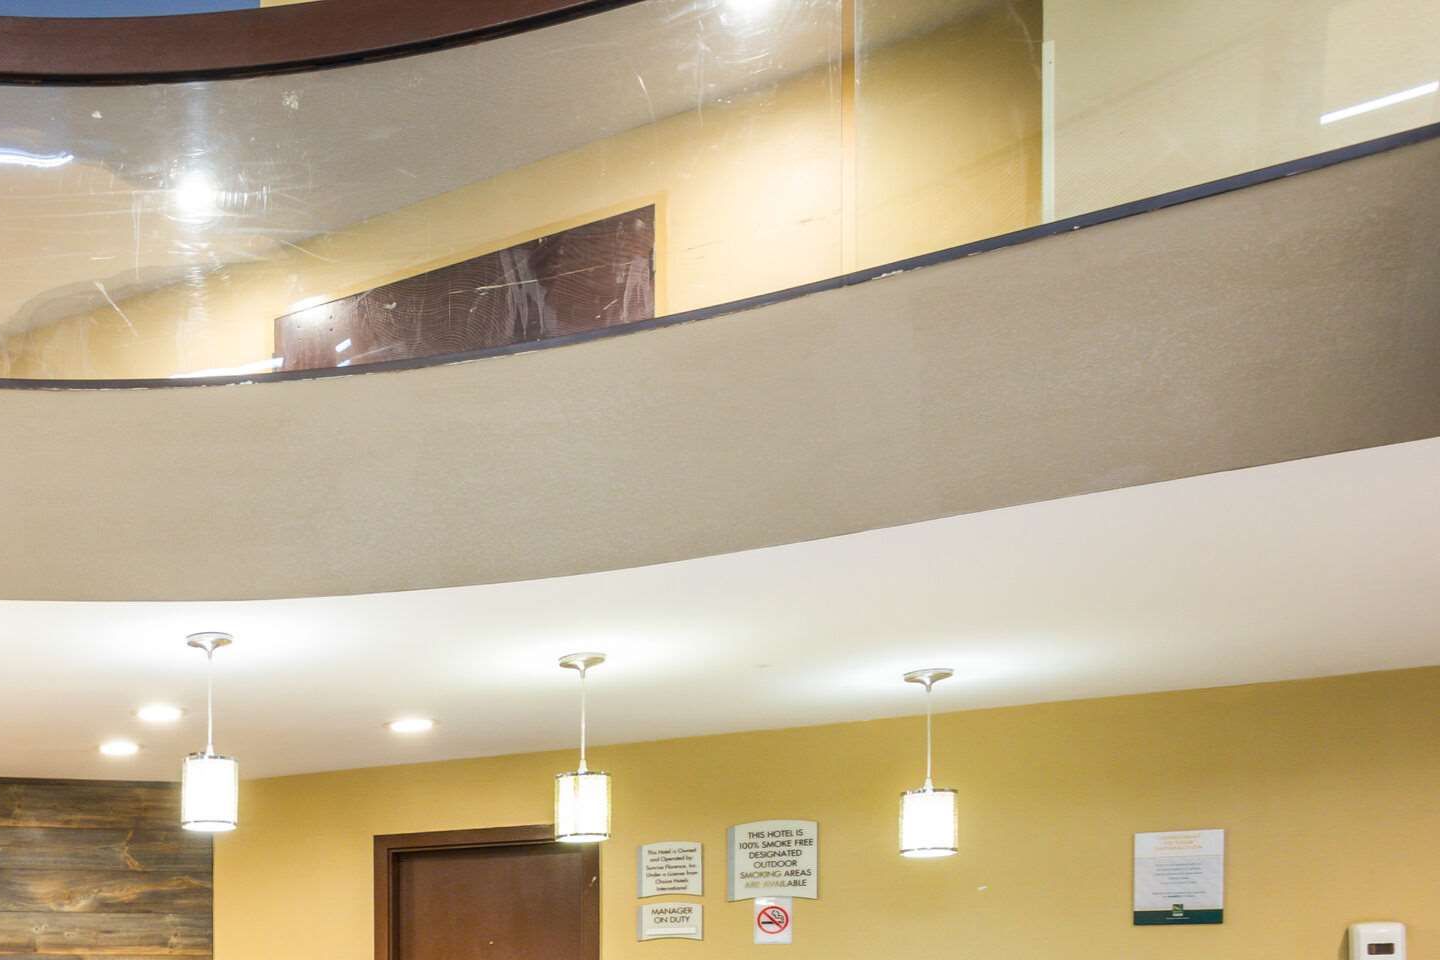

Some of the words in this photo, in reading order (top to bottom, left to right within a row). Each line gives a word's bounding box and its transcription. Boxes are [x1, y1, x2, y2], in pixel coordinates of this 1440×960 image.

[748, 831, 765, 839] THIS
[767, 830, 793, 838] HOTEL
[761, 840, 792, 848] SMOKE
[794, 838, 814, 846] FREE
[748, 849, 802, 859] DESIGNATED
[753, 860, 797, 868] OUTDOOR
[740, 871, 782, 879] SMOKING
[784, 869, 812, 877] AREAS
[764, 879, 807, 888] AVAILABLE
[651, 906, 693, 915] MANAGER
[654, 916, 668, 924] ON
[670, 915, 690, 923] DUTY
